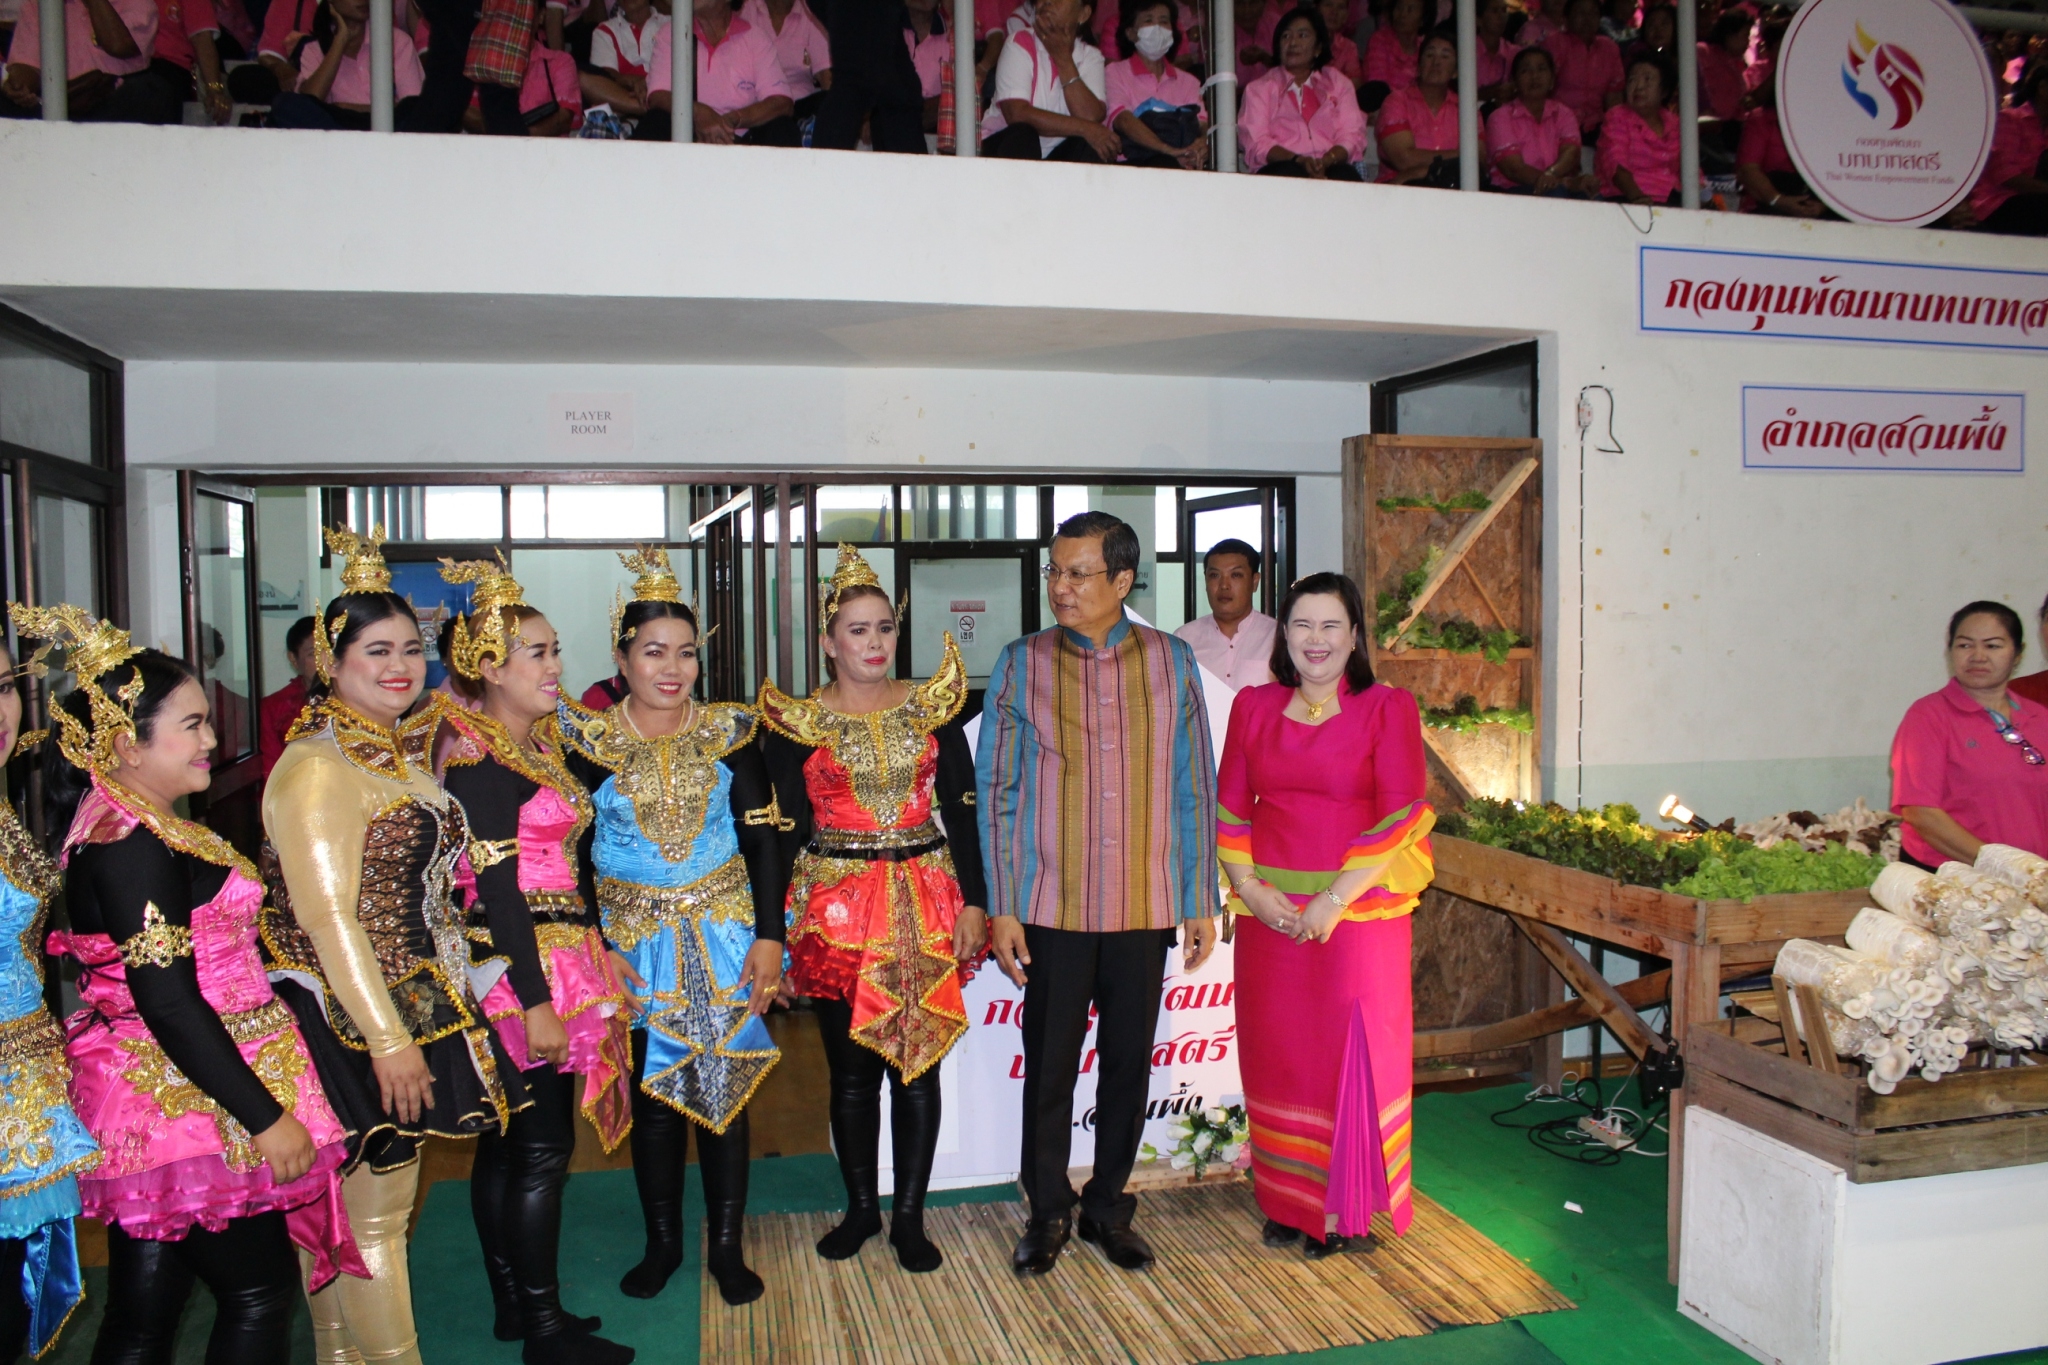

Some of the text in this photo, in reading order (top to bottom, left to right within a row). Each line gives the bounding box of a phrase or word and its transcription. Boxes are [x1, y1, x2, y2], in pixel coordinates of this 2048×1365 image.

[1838, 152, 1941, 170] บทบาทสตรี
[565, 411, 612, 421] PLAYER
[571, 425, 607, 434] ROOM
[1762, 405, 2007, 457] อำเภอสวนผึ้ง
